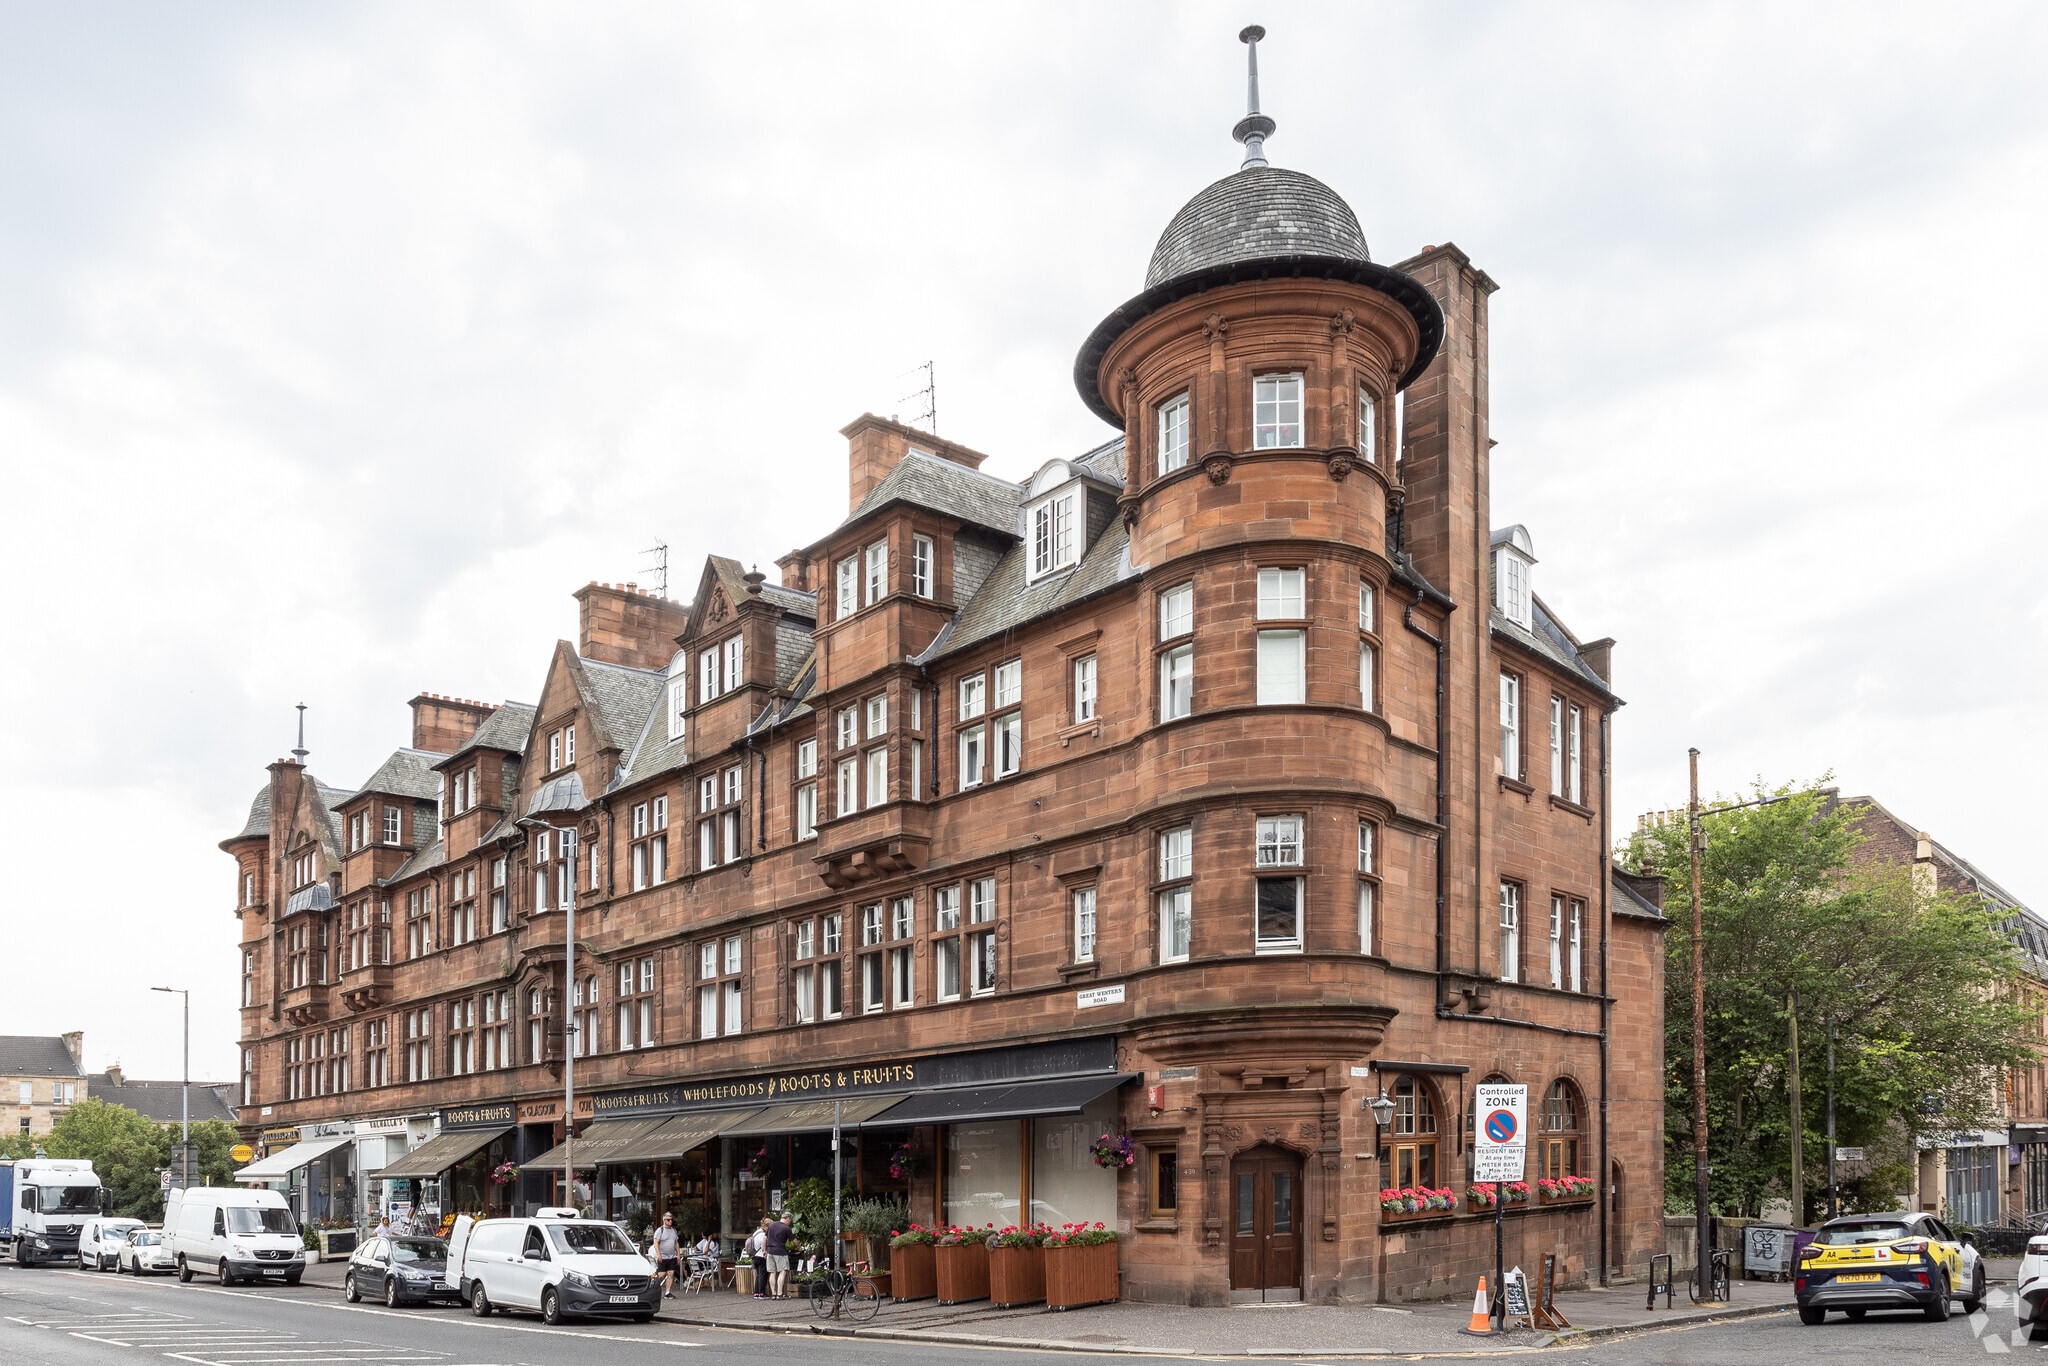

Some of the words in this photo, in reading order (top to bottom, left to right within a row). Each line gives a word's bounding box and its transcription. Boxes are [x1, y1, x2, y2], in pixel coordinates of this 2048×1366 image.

[1097, 988, 1123, 997] WESTERN
[837, 1071, 847, 1087] &
[1486, 1097, 1517, 1107] ZONE
[1183, 1168, 1196, 1176] 459
[1878, 1250, 1887, 1258] L
